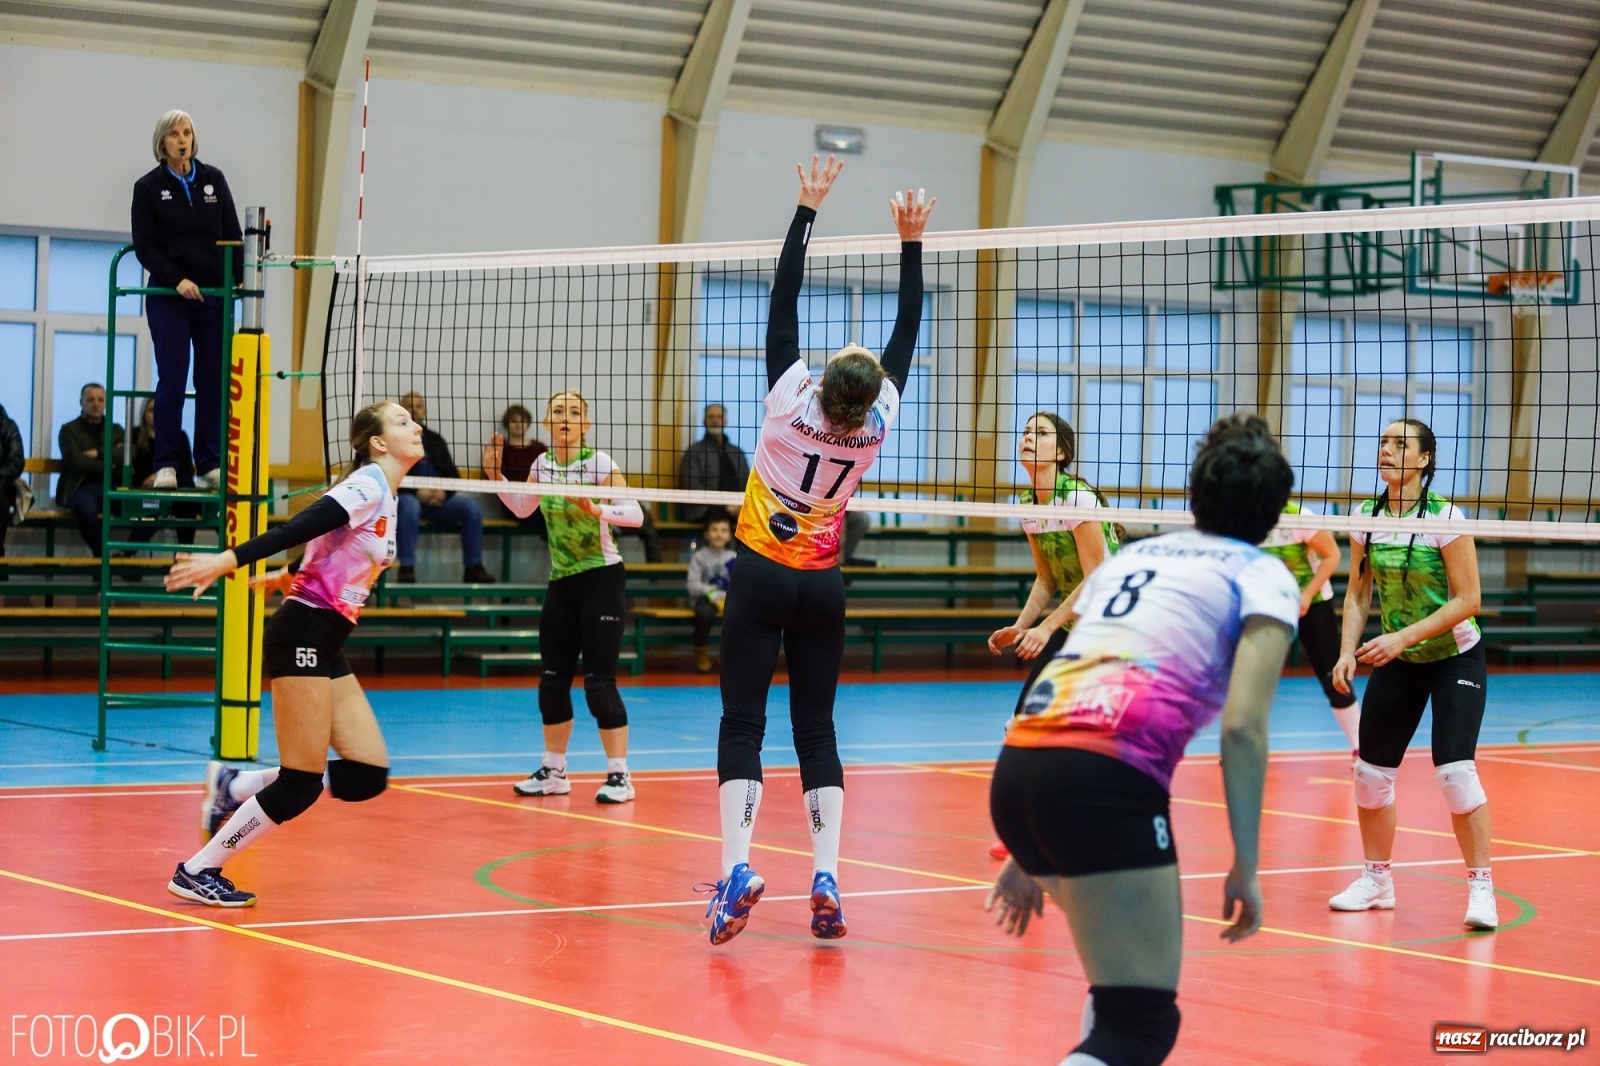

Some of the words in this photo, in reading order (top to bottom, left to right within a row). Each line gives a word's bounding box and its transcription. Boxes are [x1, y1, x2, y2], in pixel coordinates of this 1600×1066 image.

[791, 416, 814, 436] UKS
[800, 453, 855, 499] 17
[1103, 569, 1156, 618] 8
[295, 647, 317, 667] 55
[1153, 815, 1169, 850] 8
